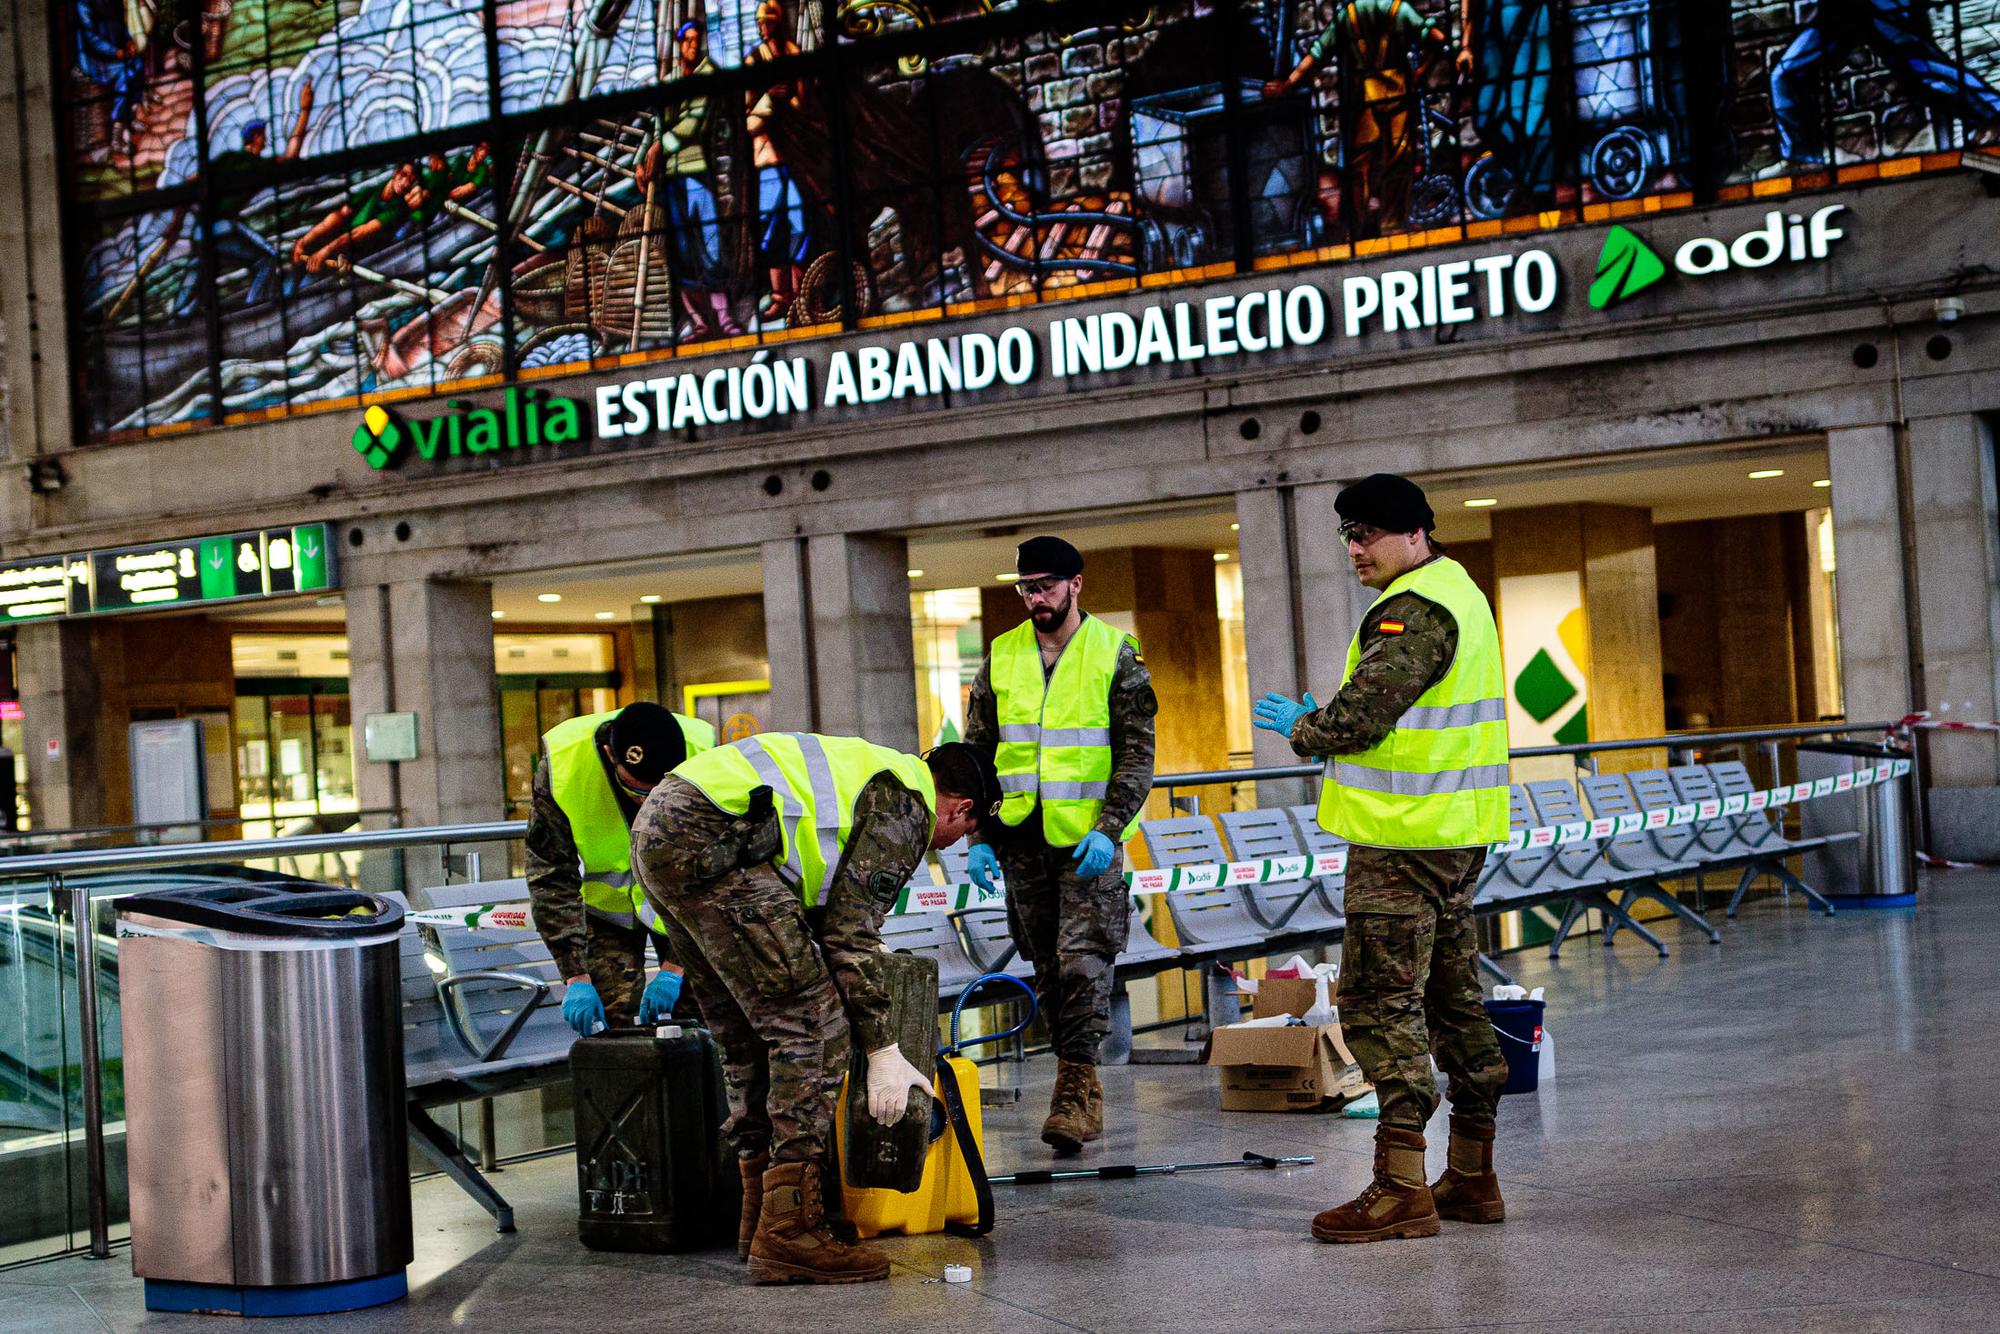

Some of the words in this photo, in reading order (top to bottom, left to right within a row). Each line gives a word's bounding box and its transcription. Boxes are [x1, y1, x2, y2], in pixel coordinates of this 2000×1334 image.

[1674, 203, 1846, 276] adif
[595, 350, 808, 439] ESTACIÓN
[824, 326, 1034, 407] ABANDO
[1049, 284, 1326, 378] INDALECIO
[1342, 248, 1558, 338] PRIETO
[407, 386, 580, 461] vialia
[916, 891, 947, 900] SEGURIDAD
